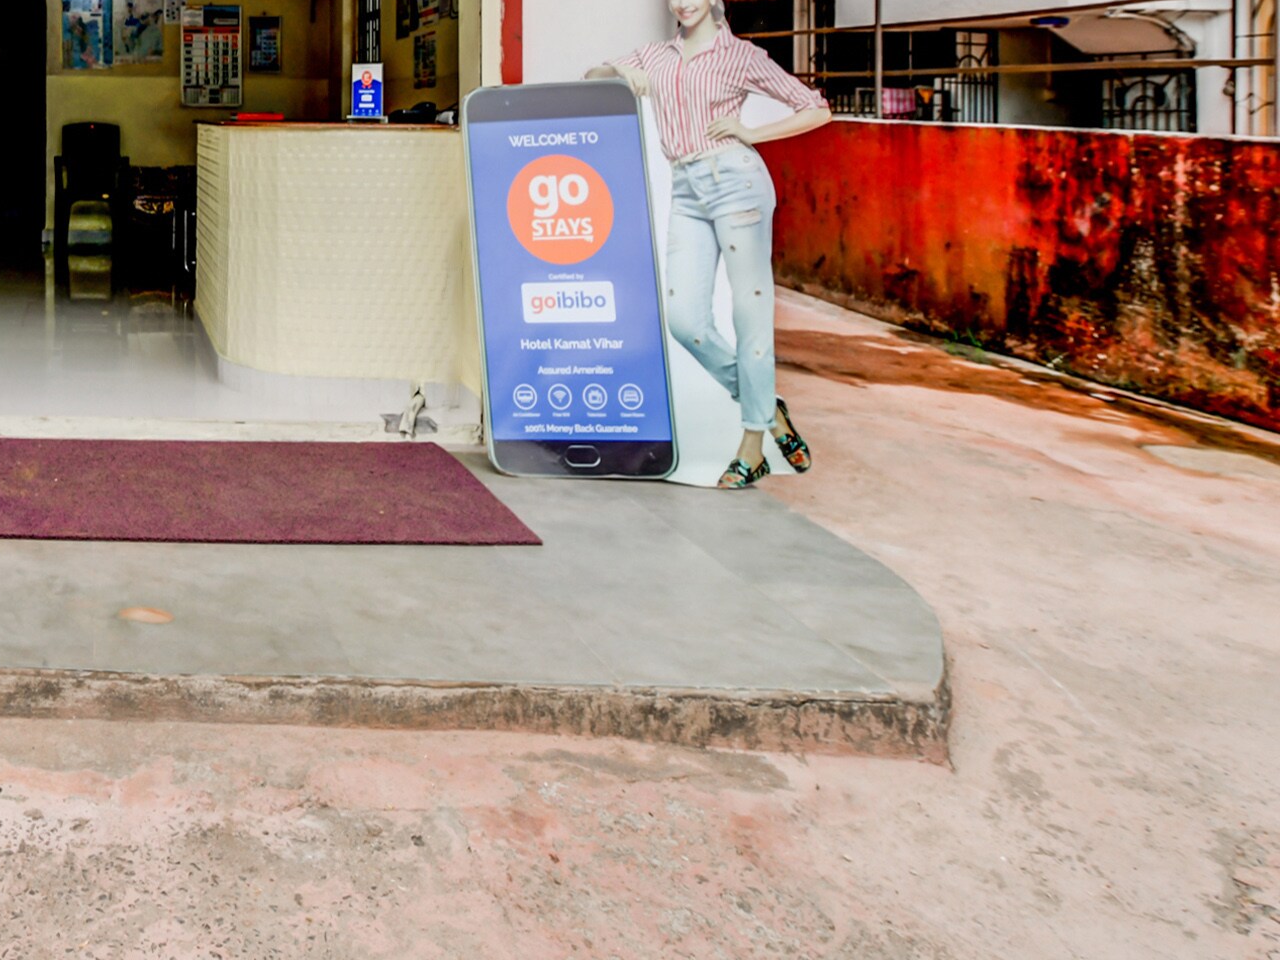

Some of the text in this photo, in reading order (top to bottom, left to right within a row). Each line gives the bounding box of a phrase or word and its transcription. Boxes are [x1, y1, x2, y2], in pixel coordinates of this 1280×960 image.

[509, 132, 599, 148] WELCOME TO
[528, 173, 589, 218] go
[531, 217, 593, 237] STAYS
[575, 273, 585, 281] by
[531, 291, 606, 315] goibibo
[520, 337, 624, 350] Hotel Kamat Vihar
[537, 365, 614, 375] Assured Amenities
[524, 423, 639, 435] 100% Money Back Guarantee
